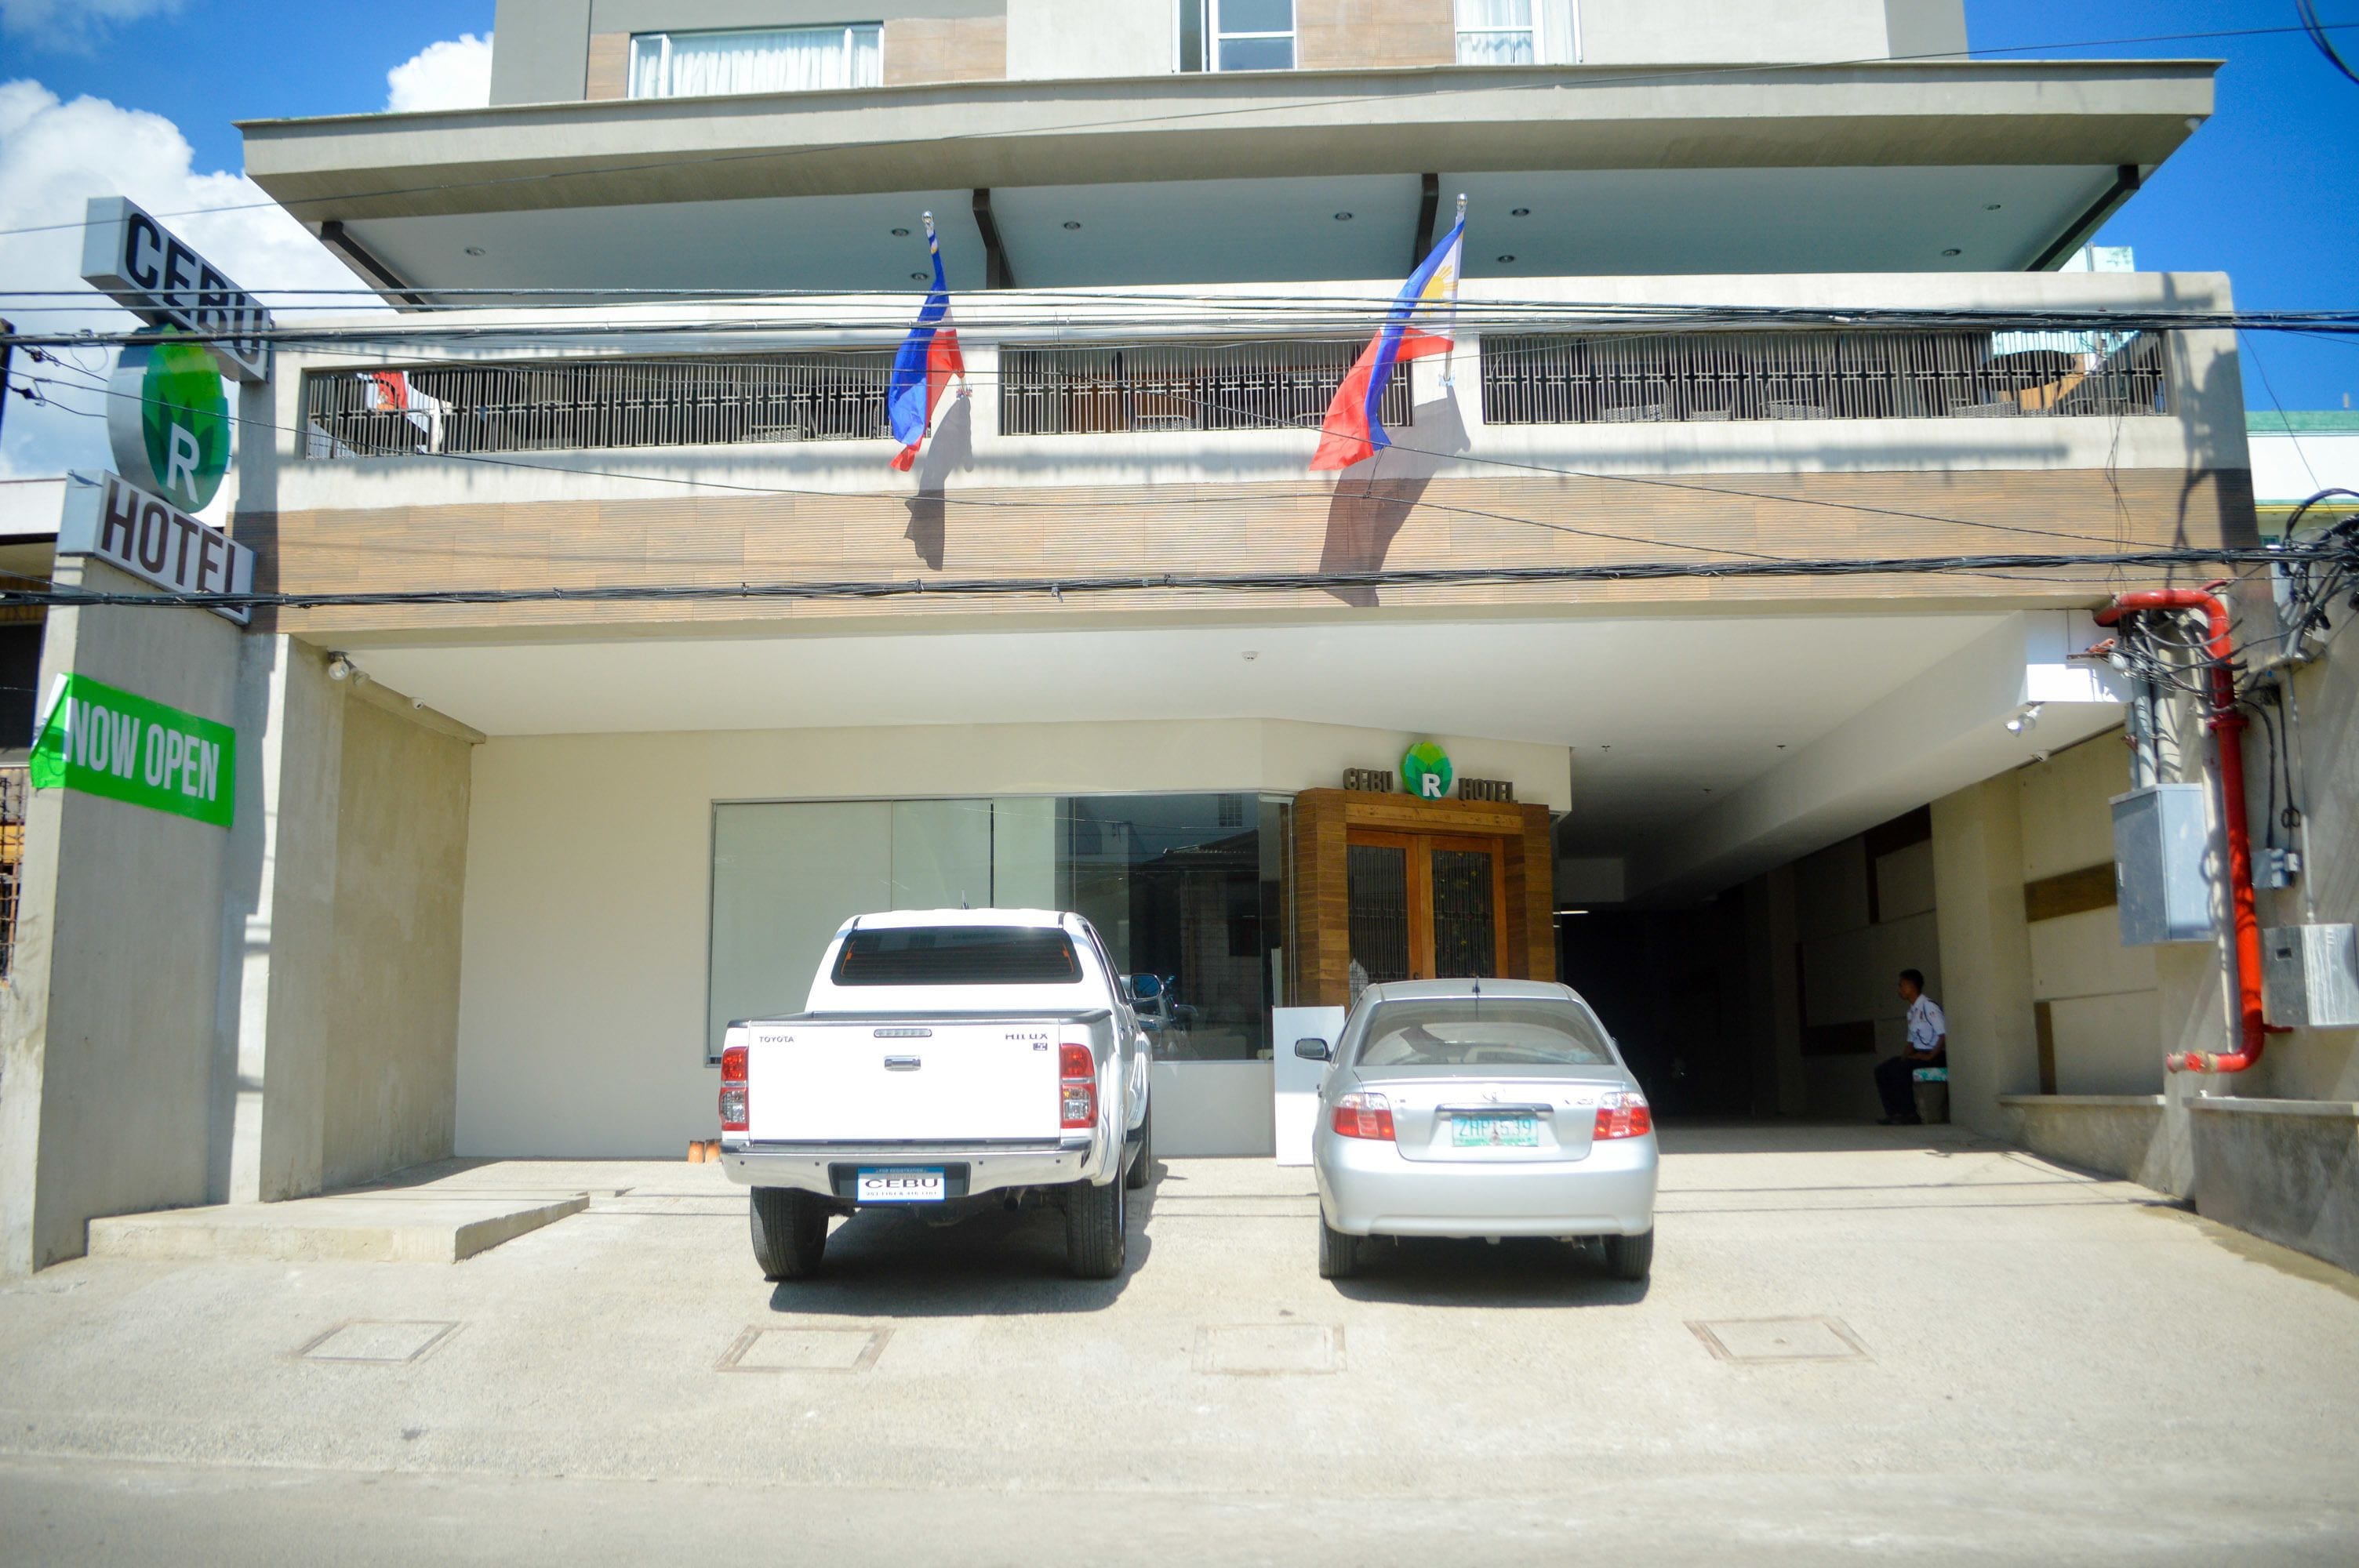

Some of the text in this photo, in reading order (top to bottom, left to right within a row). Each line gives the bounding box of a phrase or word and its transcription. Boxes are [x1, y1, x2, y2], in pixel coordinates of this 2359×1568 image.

[125, 212, 264, 365] CEBU
[166, 421, 200, 506] R
[100, 478, 244, 615] HOTEL
[63, 696, 220, 802] NOW OPEN
[1343, 767, 1394, 793] CEBU
[1422, 773, 1441, 797] R
[1459, 777, 1518, 804] HOTEL
[865, 1178, 938, 1189] CEBU
